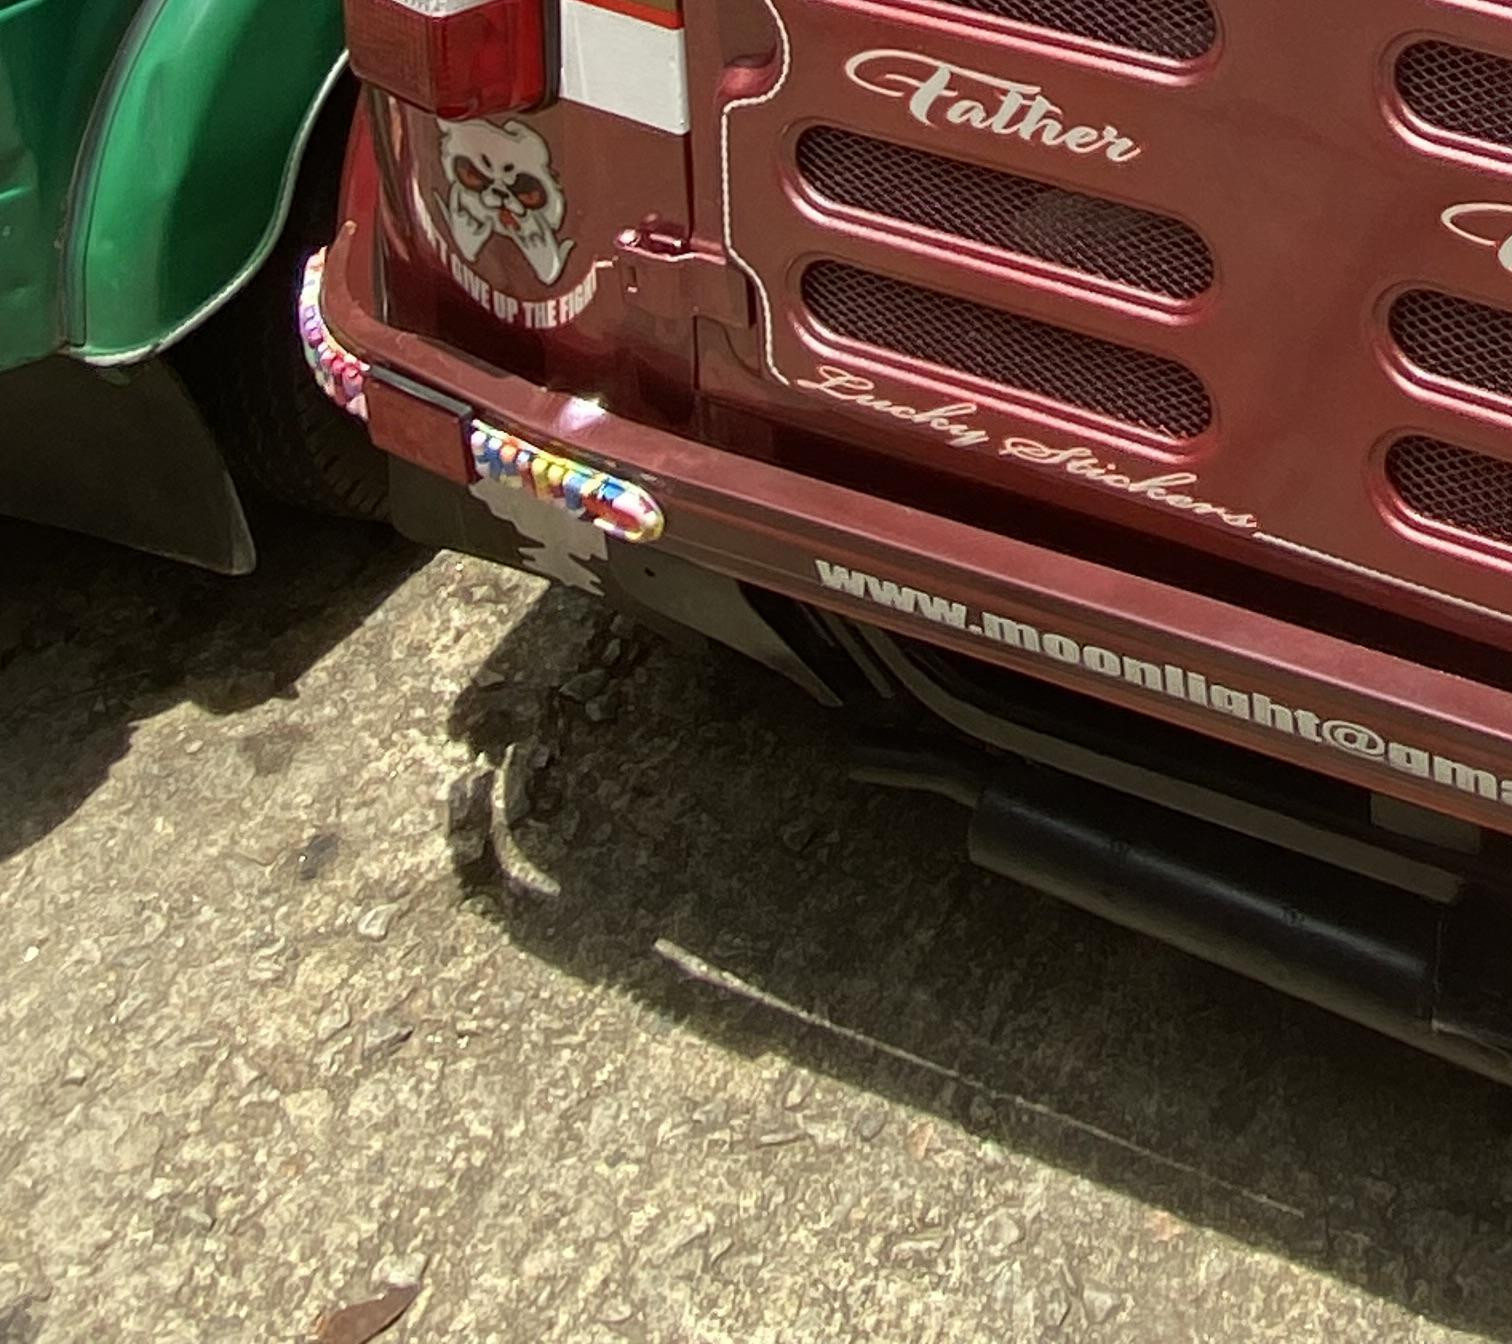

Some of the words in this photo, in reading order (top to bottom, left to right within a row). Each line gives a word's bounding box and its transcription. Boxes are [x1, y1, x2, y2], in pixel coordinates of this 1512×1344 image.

[845, 48, 1142, 164] Father
[522, 300, 558, 329] THE
[797, 365, 990, 447] Lucky
